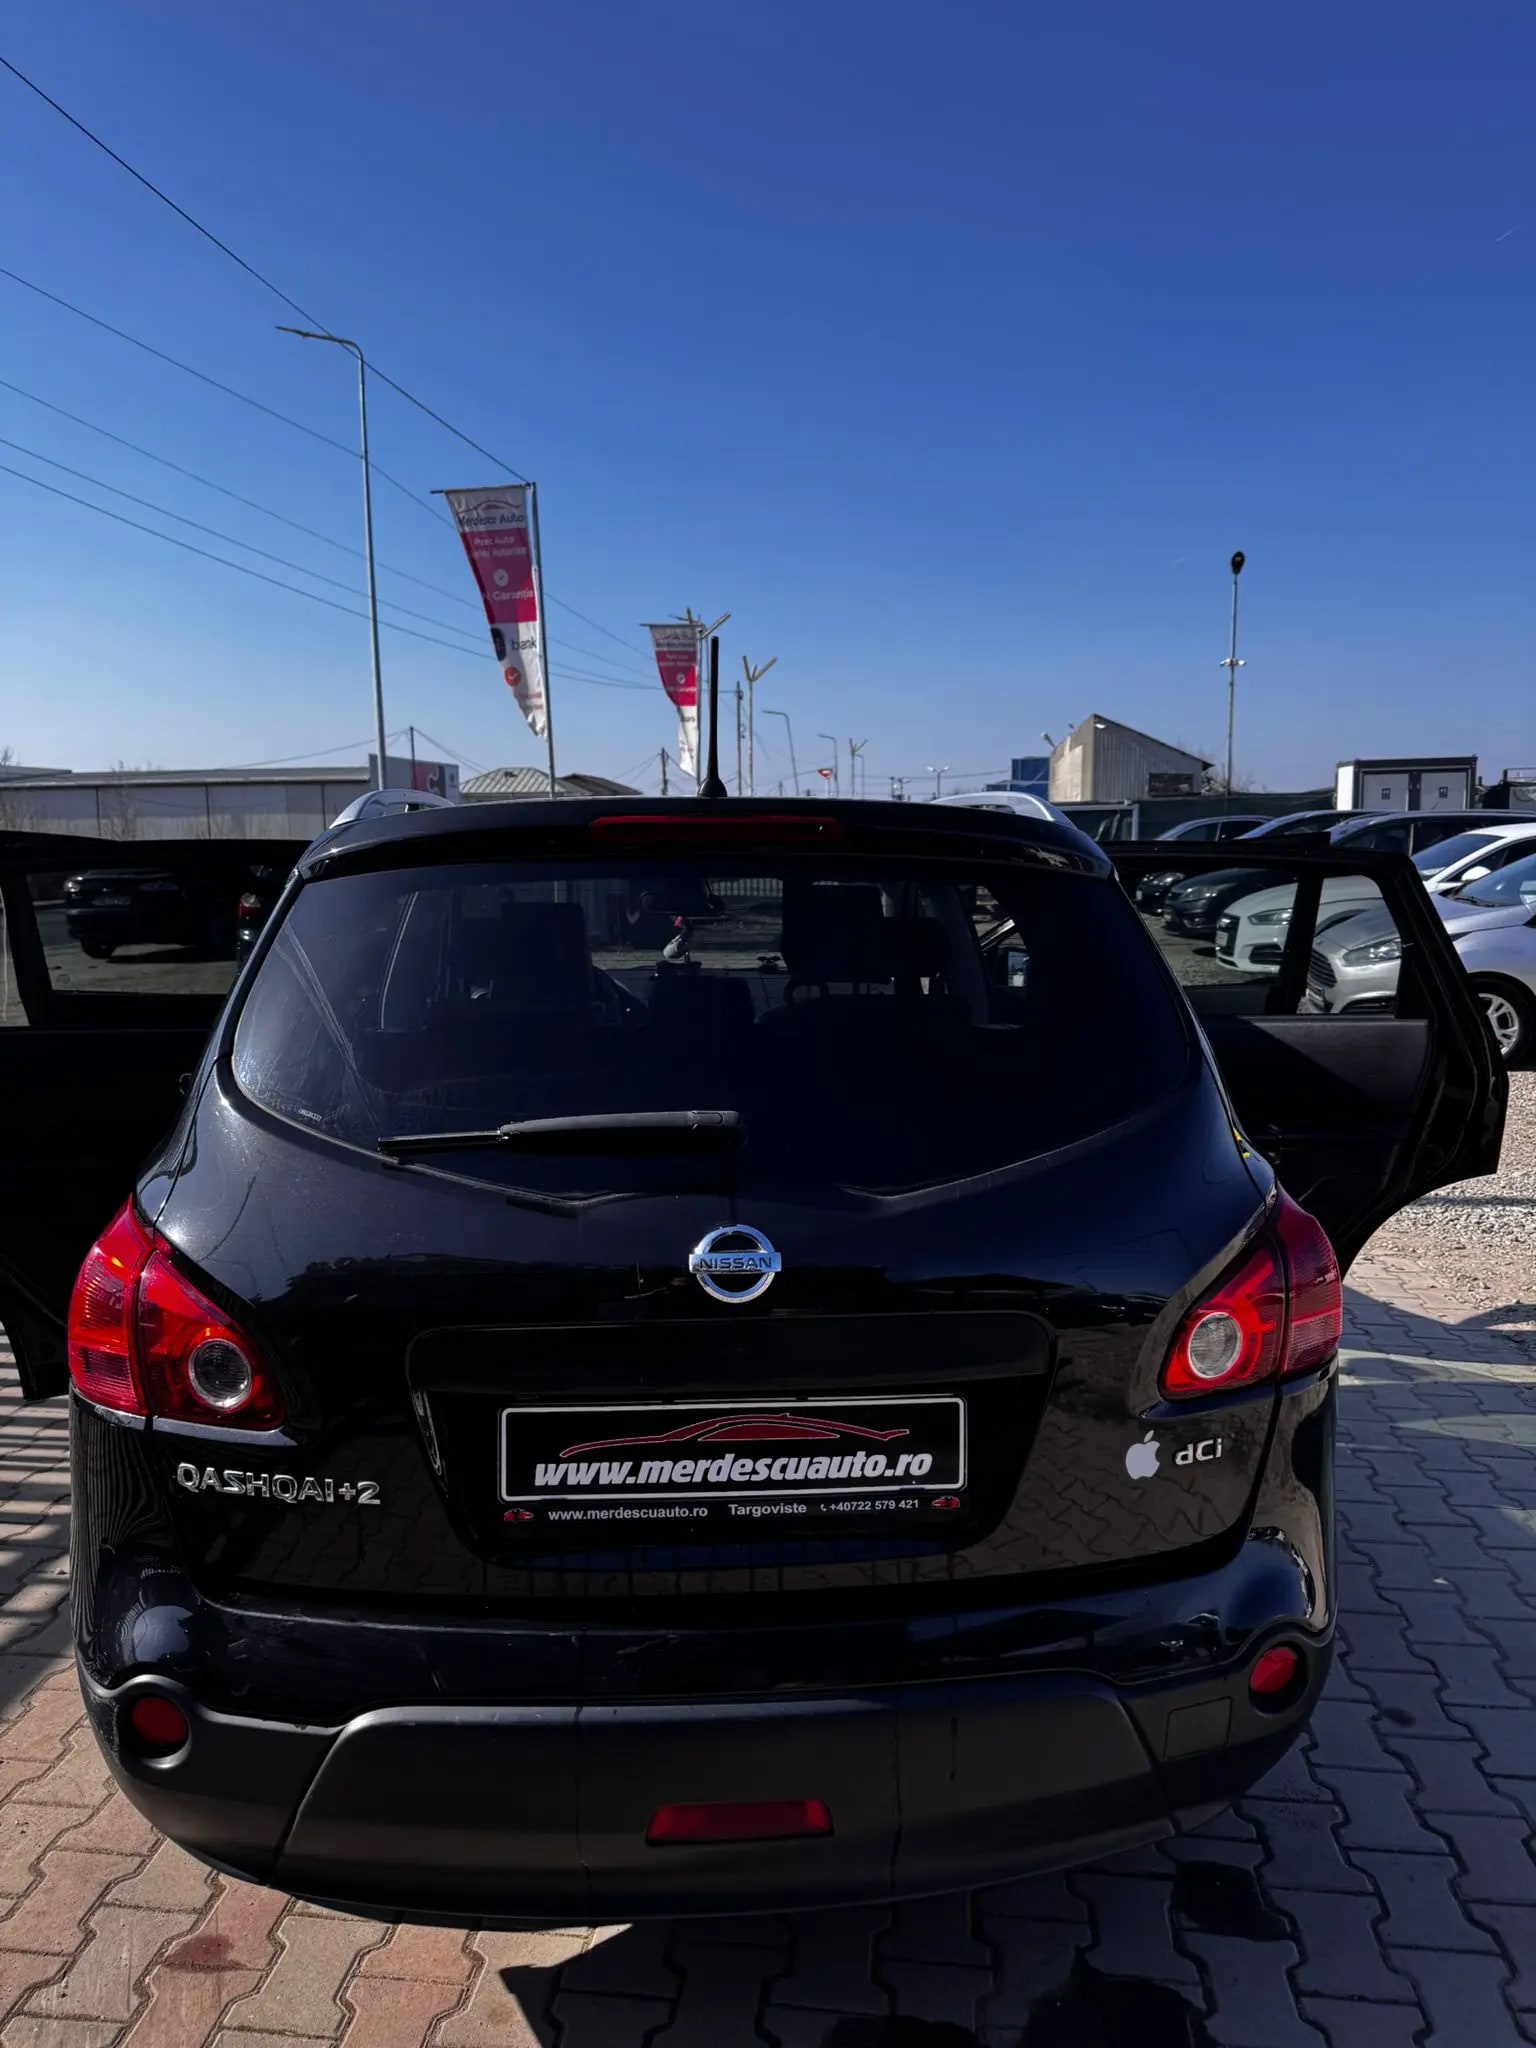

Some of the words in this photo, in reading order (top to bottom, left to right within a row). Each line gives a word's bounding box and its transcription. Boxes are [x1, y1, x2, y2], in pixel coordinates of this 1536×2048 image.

[499, 511, 525, 525] Auto
[511, 636, 537, 650] bank
[699, 1256, 773, 1270] NISSAN
[1175, 1438, 1222, 1465] dCi
[534, 1452, 934, 1487] www.merdescuauto.ro
[548, 1504, 709, 1521] www.merdescuauto.ro
[728, 1501, 808, 1518] Targoviste
[829, 1501, 872, 1513] +40722
[874, 1500, 897, 1511] 579
[899, 1499, 919, 1510] 421
